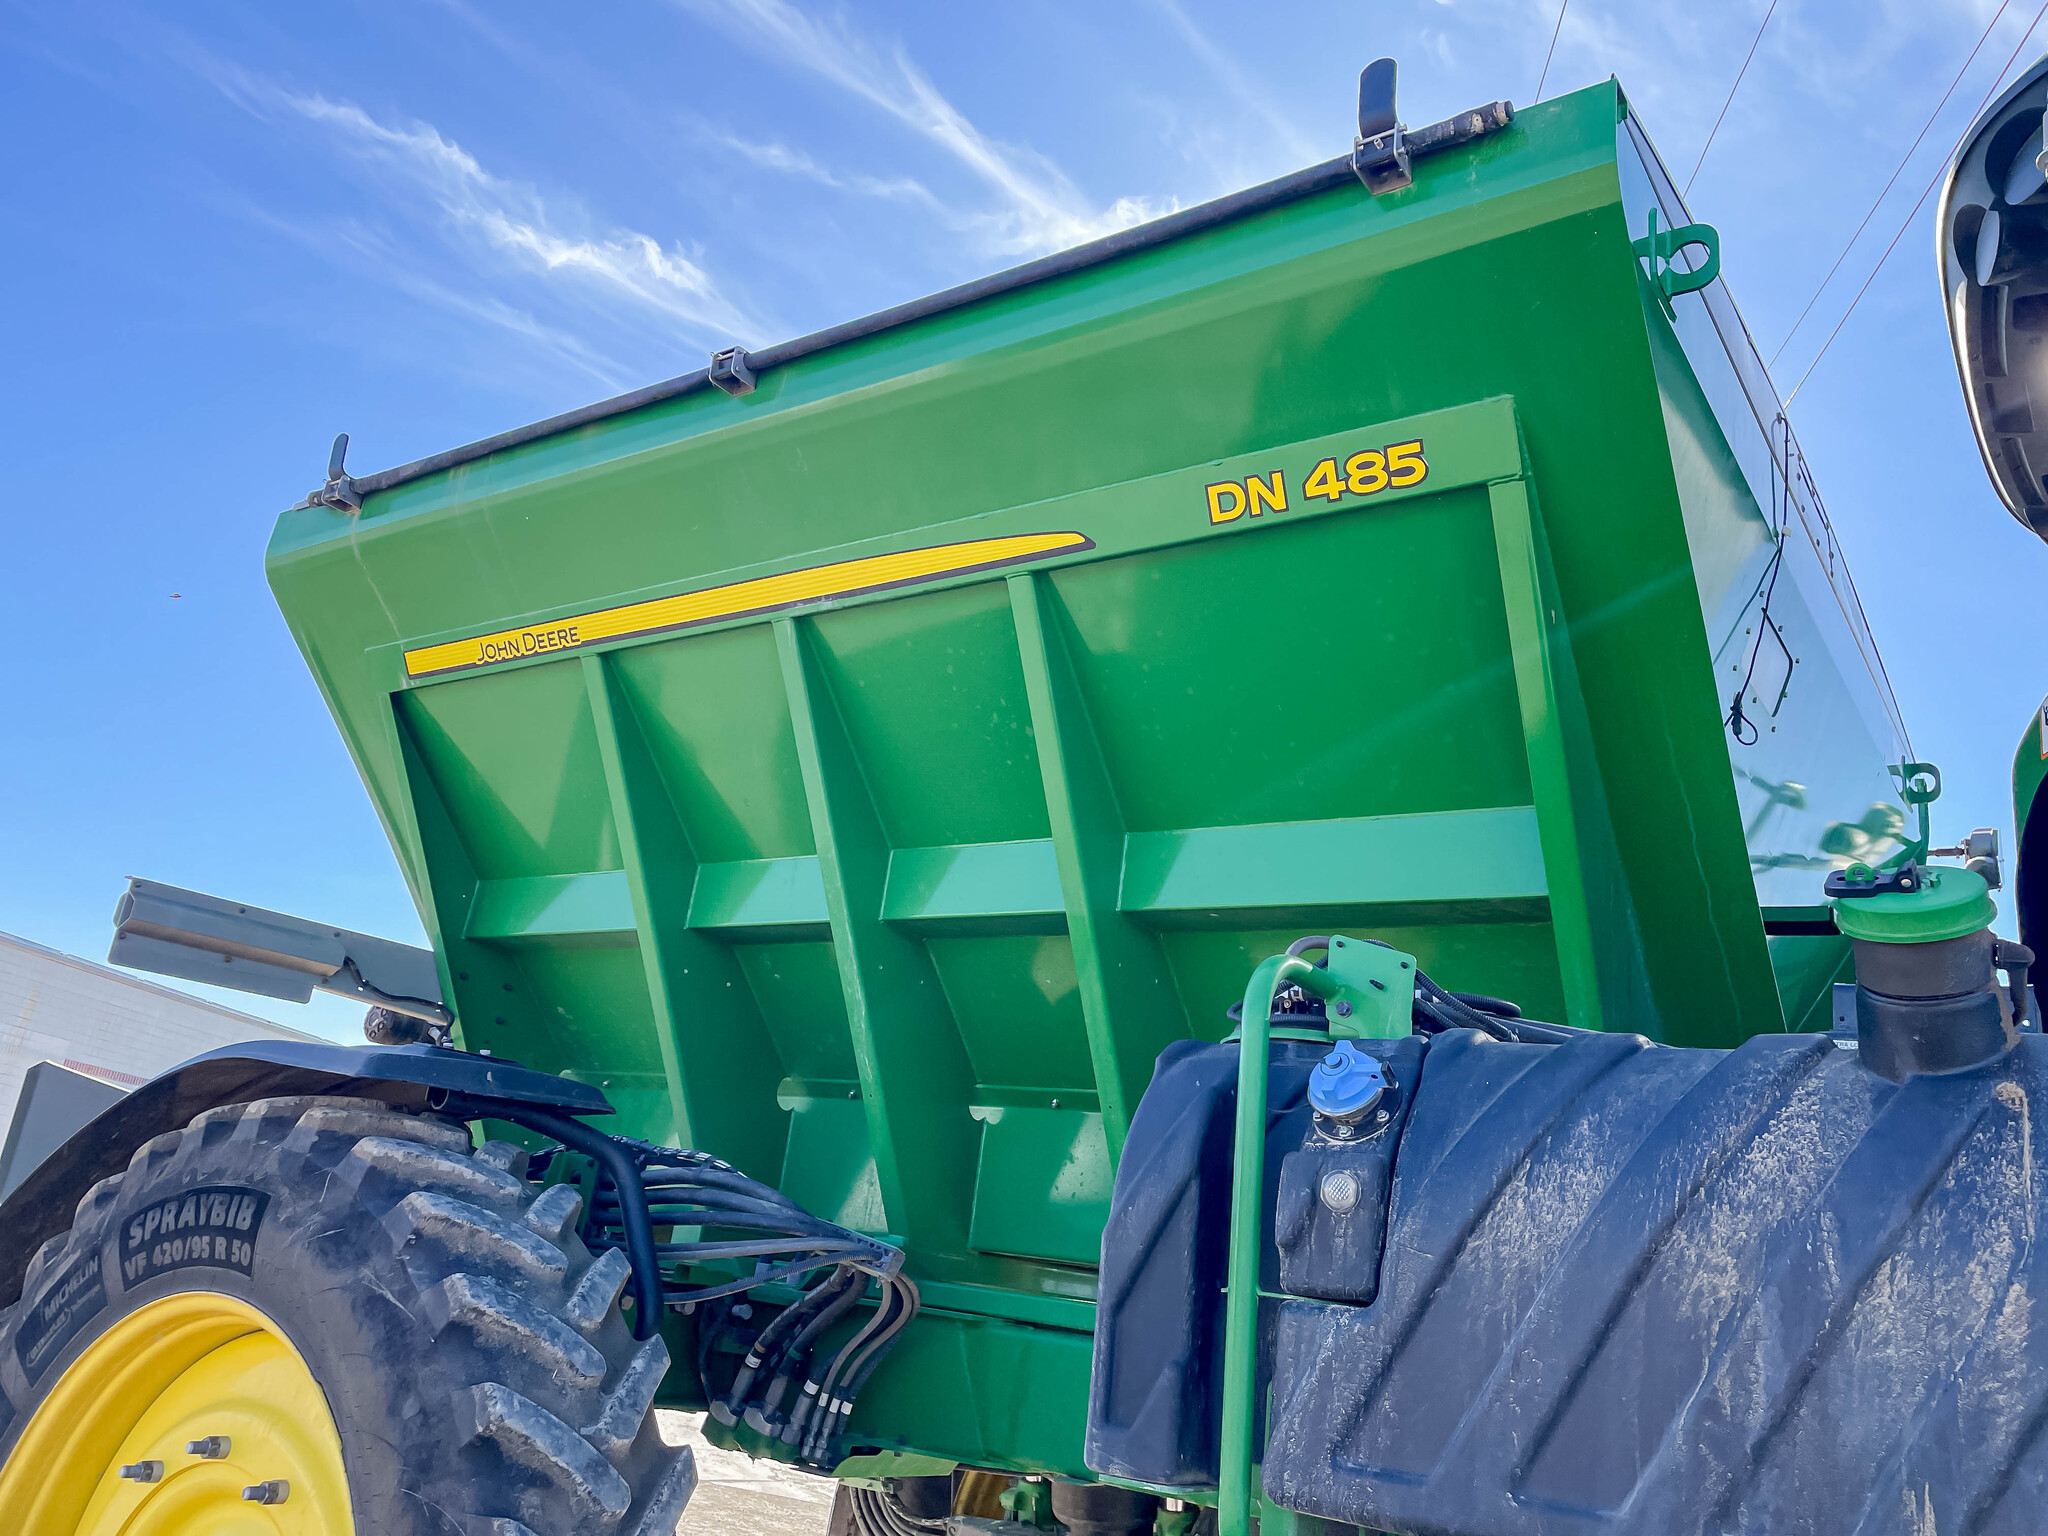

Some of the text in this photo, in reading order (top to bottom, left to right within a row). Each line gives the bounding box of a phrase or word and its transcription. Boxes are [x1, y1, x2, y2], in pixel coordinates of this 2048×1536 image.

[1205, 438, 1429, 526] DN 485
[477, 626, 581, 662] JOHN DEERE
[128, 1192, 258, 1249] SPRAYBIB
[124, 1235, 251, 1281] VF 420/95 R 50
[43, 1255, 99, 1322] MICHELIN
